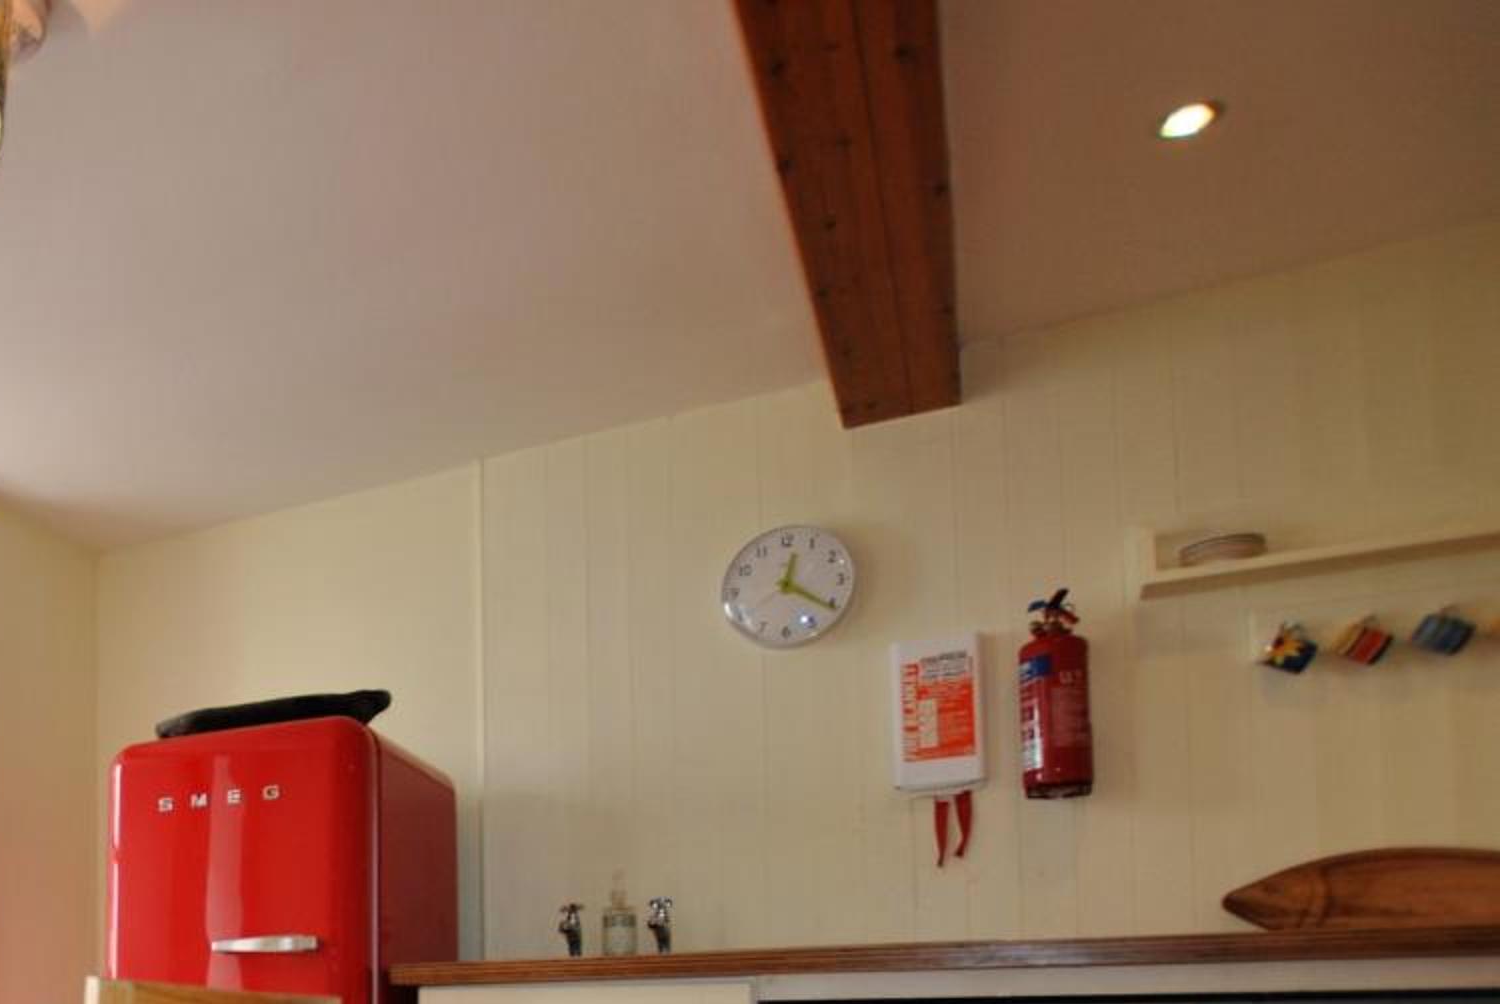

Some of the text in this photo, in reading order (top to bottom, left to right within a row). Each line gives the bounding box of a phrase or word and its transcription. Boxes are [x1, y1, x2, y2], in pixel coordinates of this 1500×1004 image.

[780, 534, 794, 548] 12
[755, 545, 768, 558] 11
[828, 549, 837, 563] 2
[739, 564, 752, 577] 10
[837, 571, 845, 586] 3
[157, 784, 279, 813] SMEG
